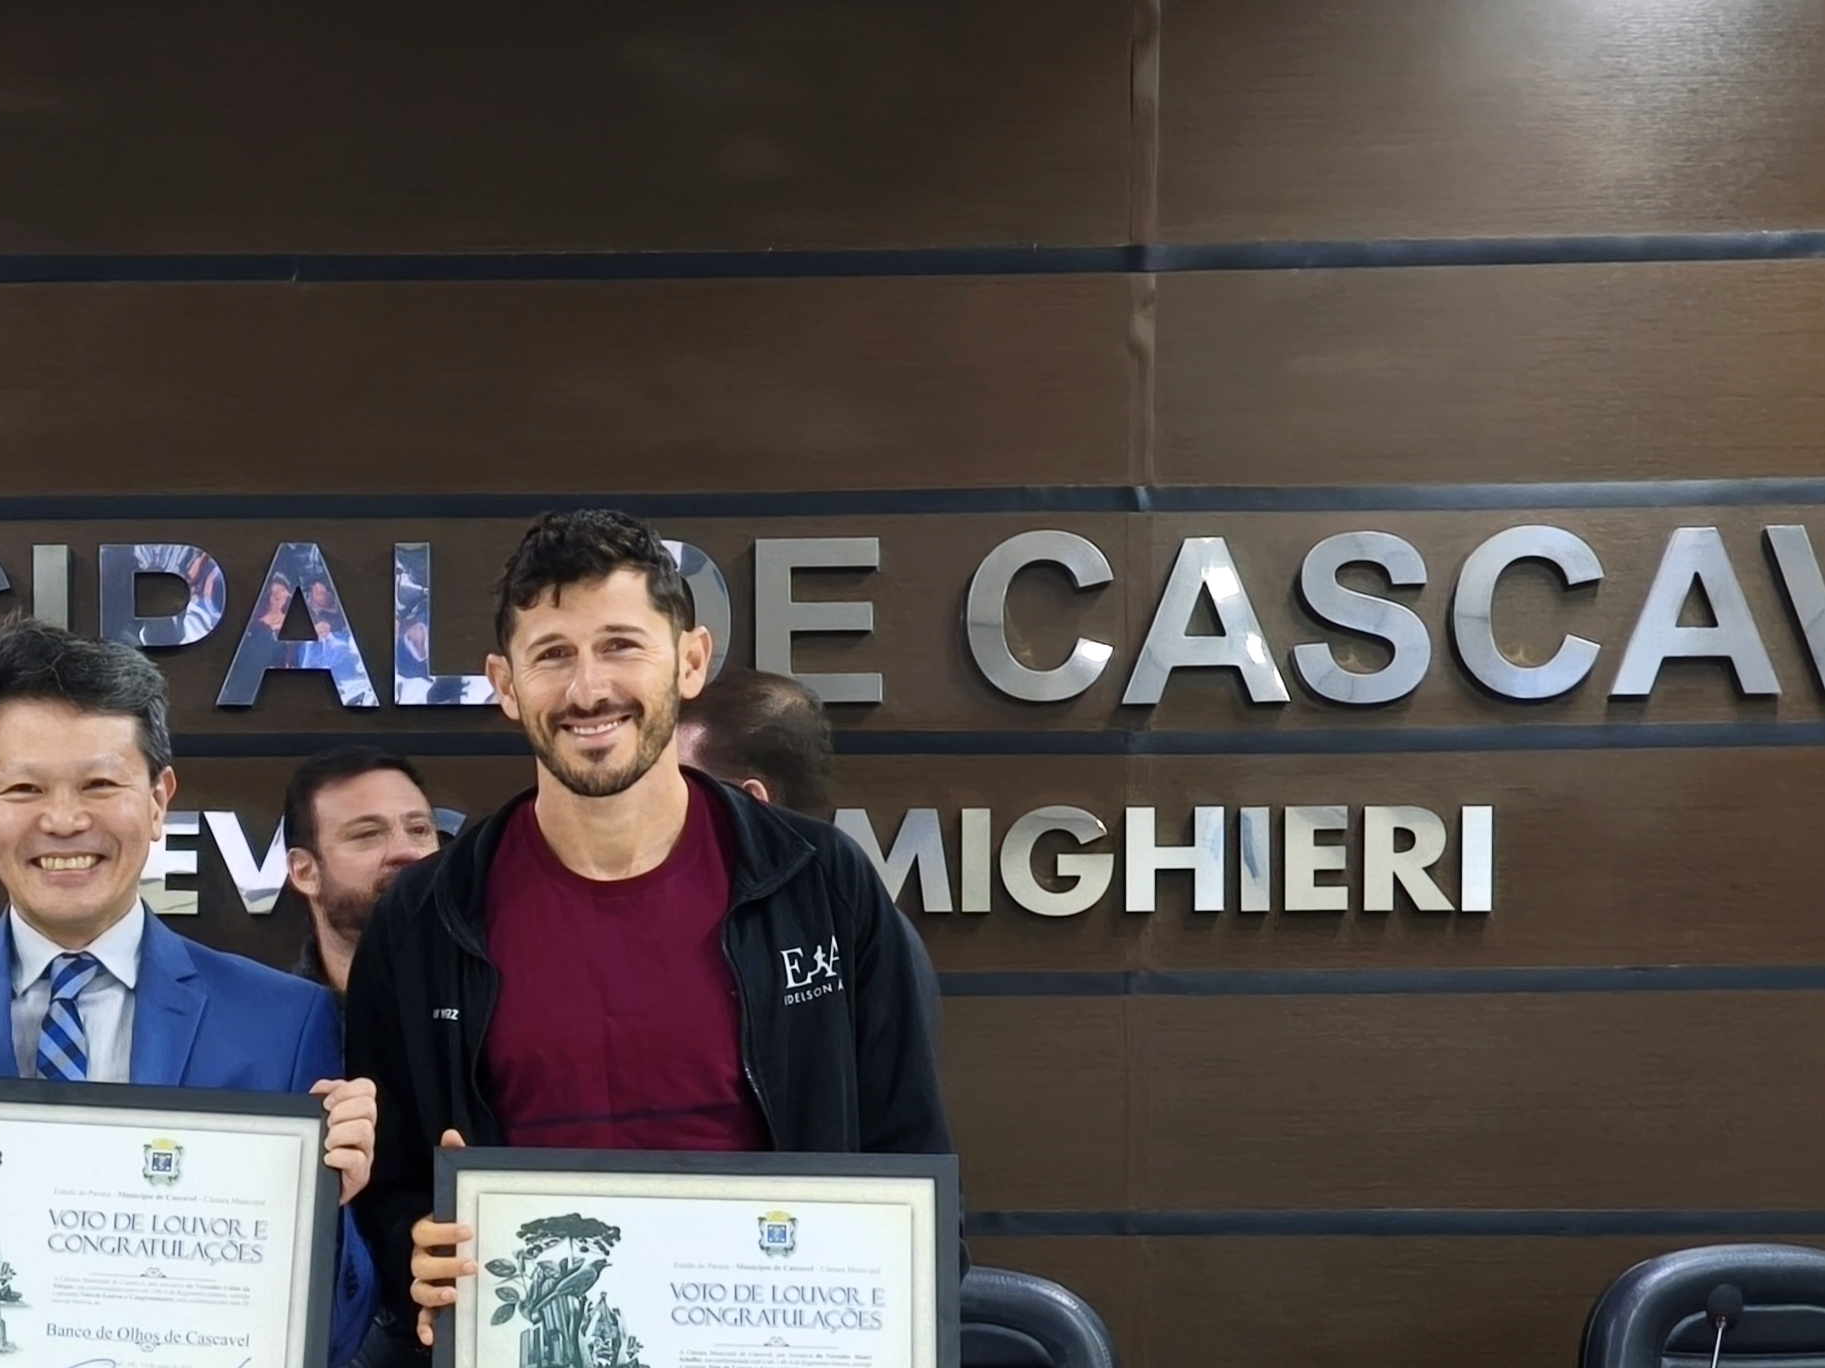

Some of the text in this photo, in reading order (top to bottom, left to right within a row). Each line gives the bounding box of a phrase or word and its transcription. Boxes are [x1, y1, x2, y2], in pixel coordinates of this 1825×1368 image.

[831, 804, 1495, 918] MIGHIERI
[48, 1208, 269, 1241] VOTO DE LOUVOR E
[47, 1233, 264, 1266] CONGRATULAÇÕES
[670, 1282, 886, 1308] VOTO DE LOUVOR E
[671, 1306, 883, 1333] CONGRATULAÇÕES
[46, 1322, 250, 1348] Banco de Olhos de Cascavel
